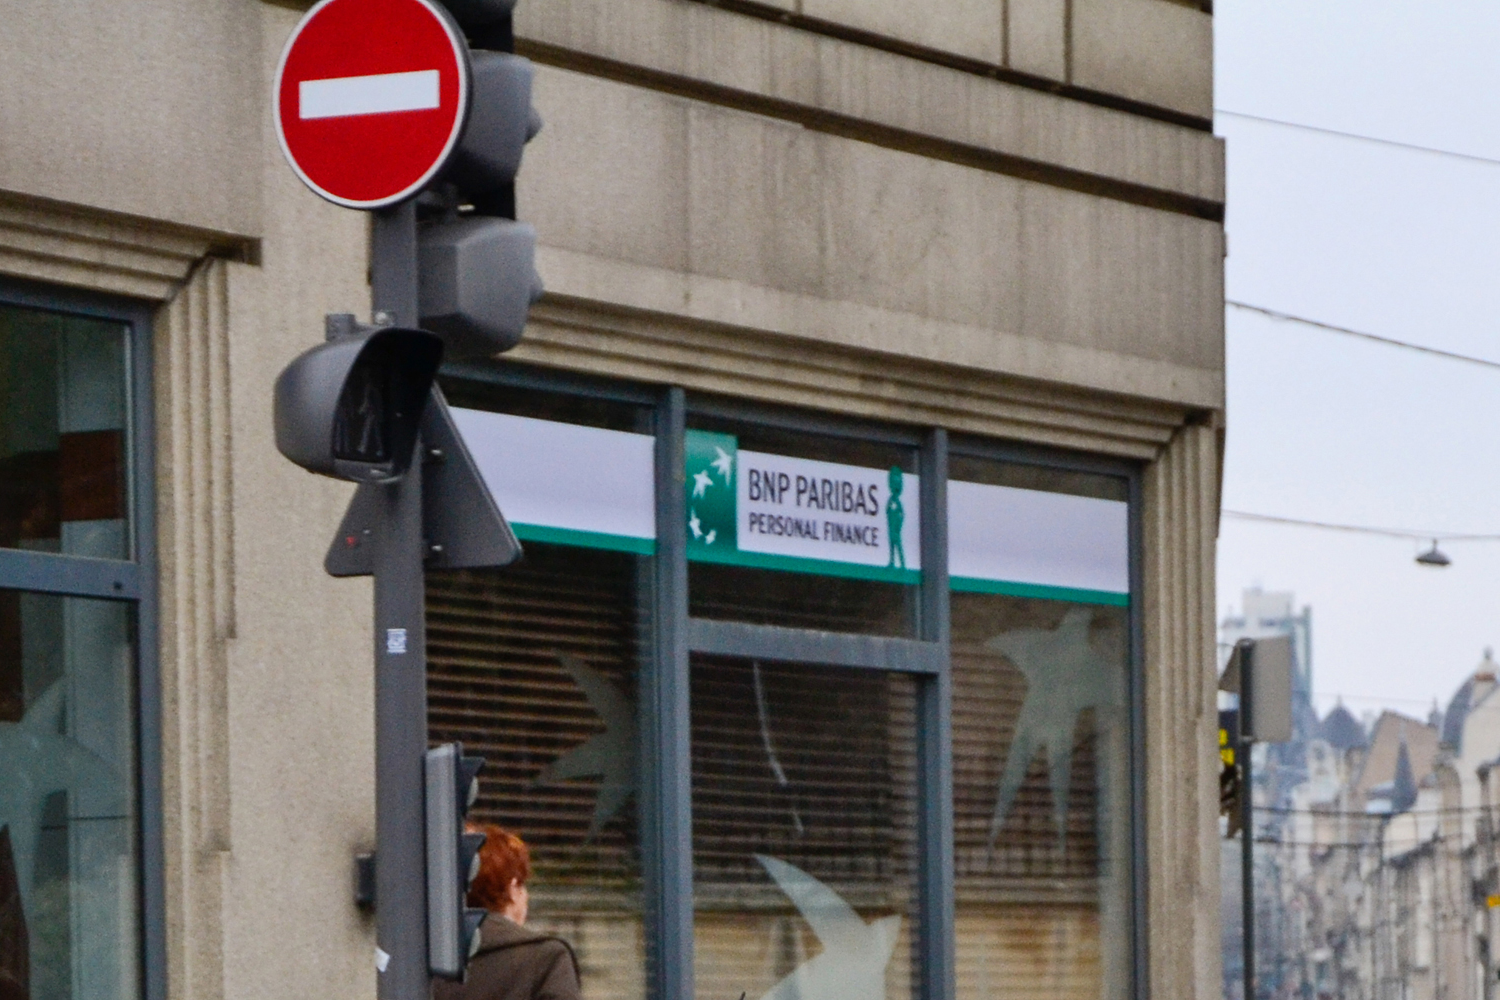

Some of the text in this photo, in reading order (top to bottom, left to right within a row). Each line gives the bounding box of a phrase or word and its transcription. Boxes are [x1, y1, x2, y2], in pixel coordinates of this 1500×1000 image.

[749, 469, 879, 515] BNP PARIBAS
[749, 512, 879, 547] PERSONAL FINANCE
